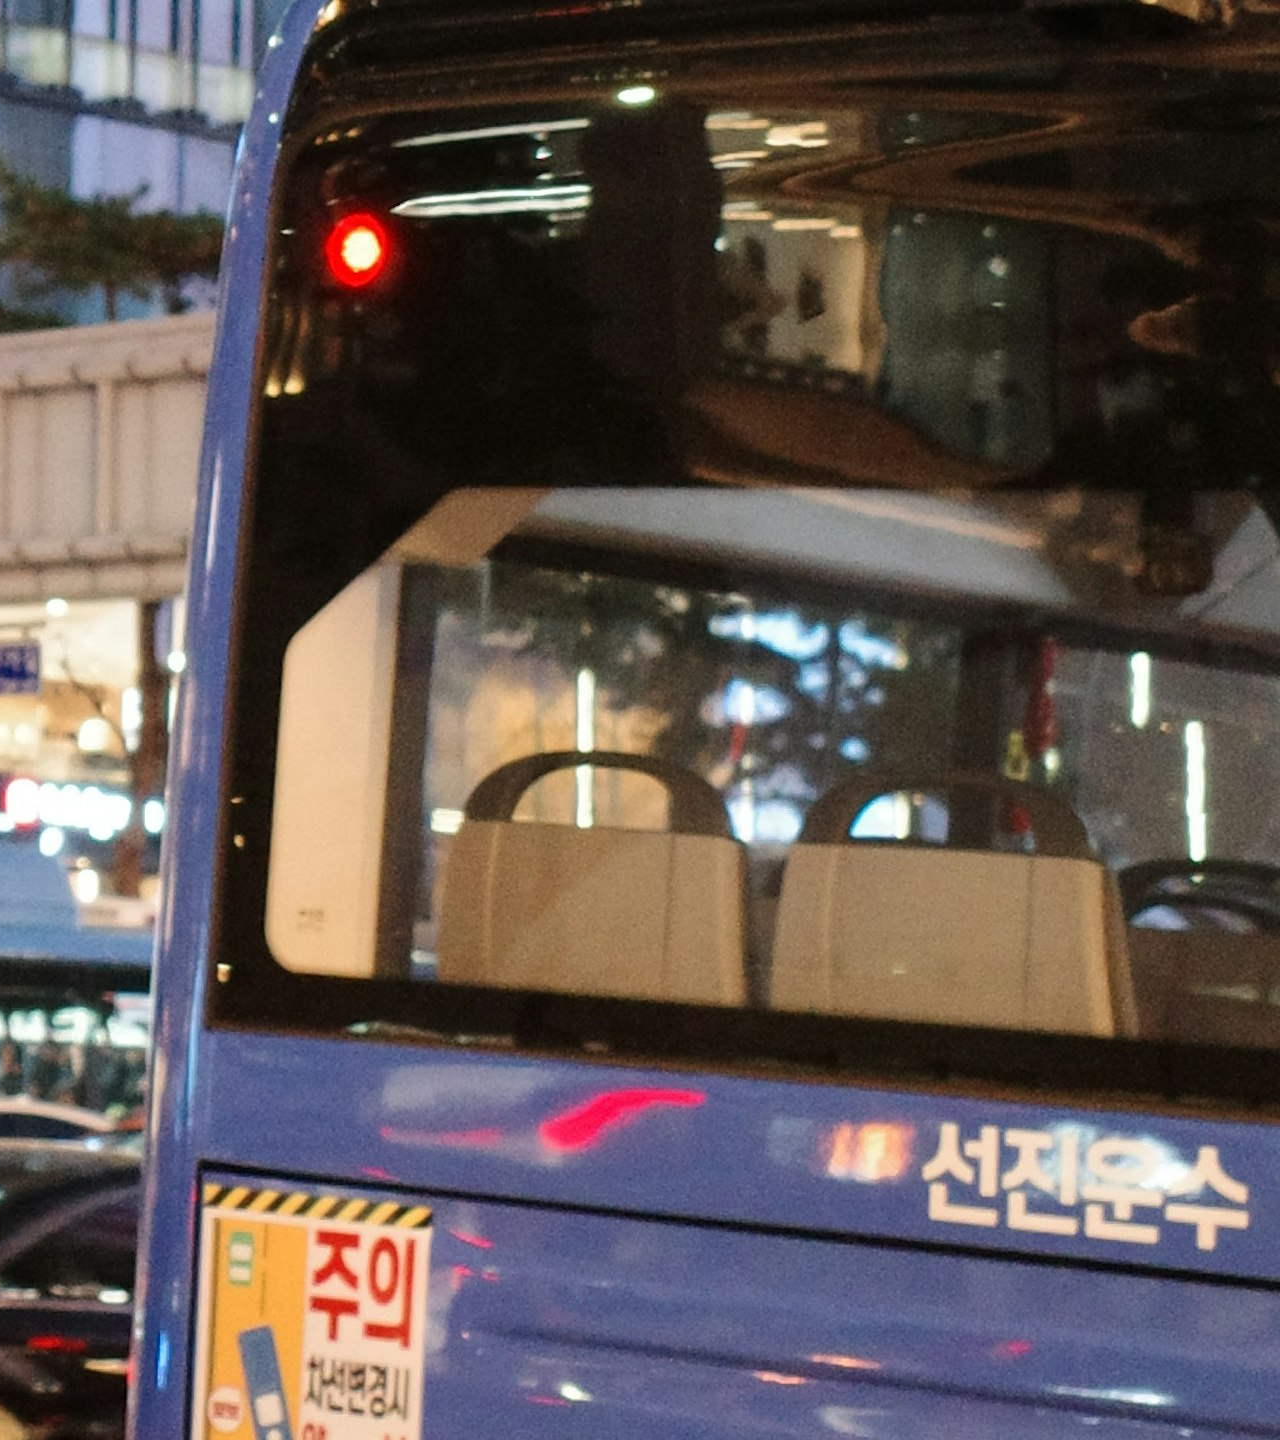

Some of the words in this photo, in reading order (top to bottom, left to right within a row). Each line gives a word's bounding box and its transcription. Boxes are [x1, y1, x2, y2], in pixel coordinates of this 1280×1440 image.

[921, 1121, 1250, 1253] 선진운수
[310, 1229, 417, 1351] 주의
[304, 1355, 410, 1421] 차선변경시
